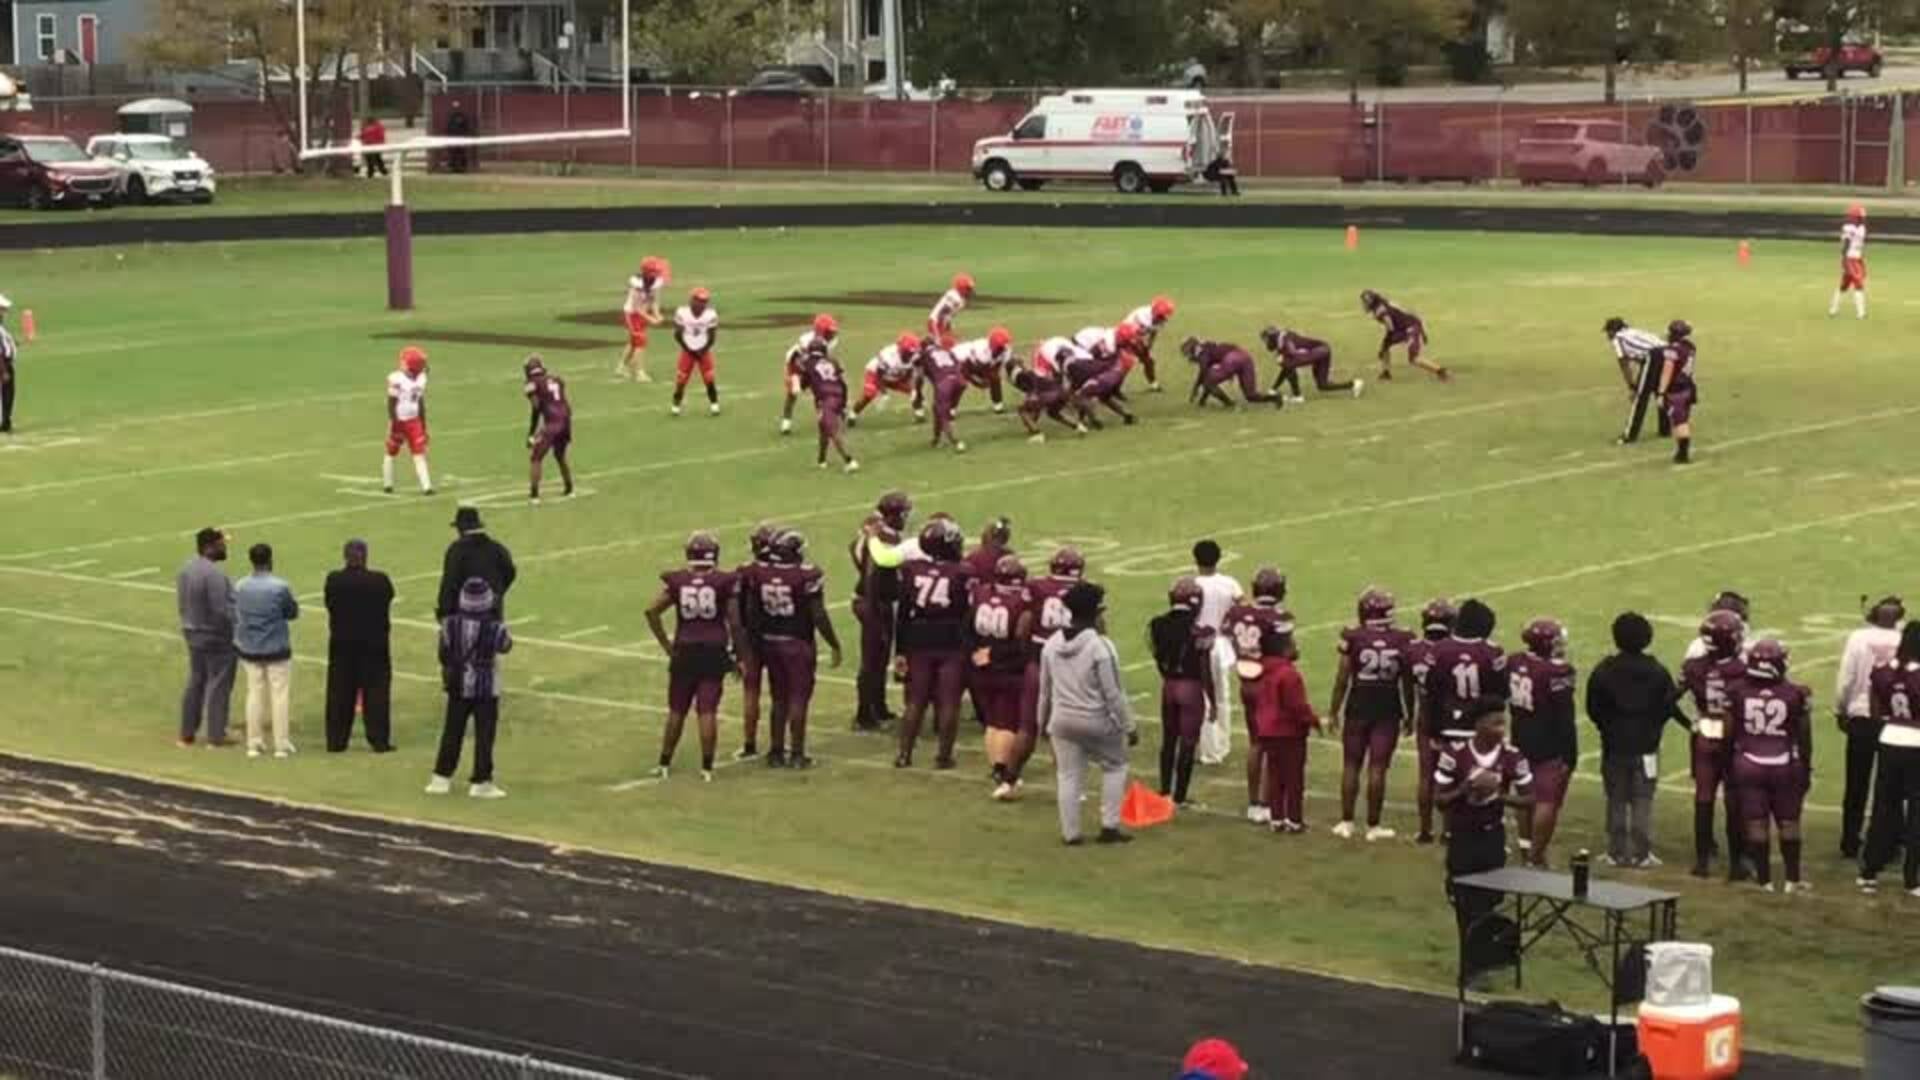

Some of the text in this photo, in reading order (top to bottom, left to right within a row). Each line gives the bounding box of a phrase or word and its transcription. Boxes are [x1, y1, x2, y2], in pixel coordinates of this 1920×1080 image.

[914, 575, 951, 608] 74
[1358, 649, 1400, 681] 25
[1452, 661, 1481, 699] 11
[1743, 697, 1788, 735] 52
